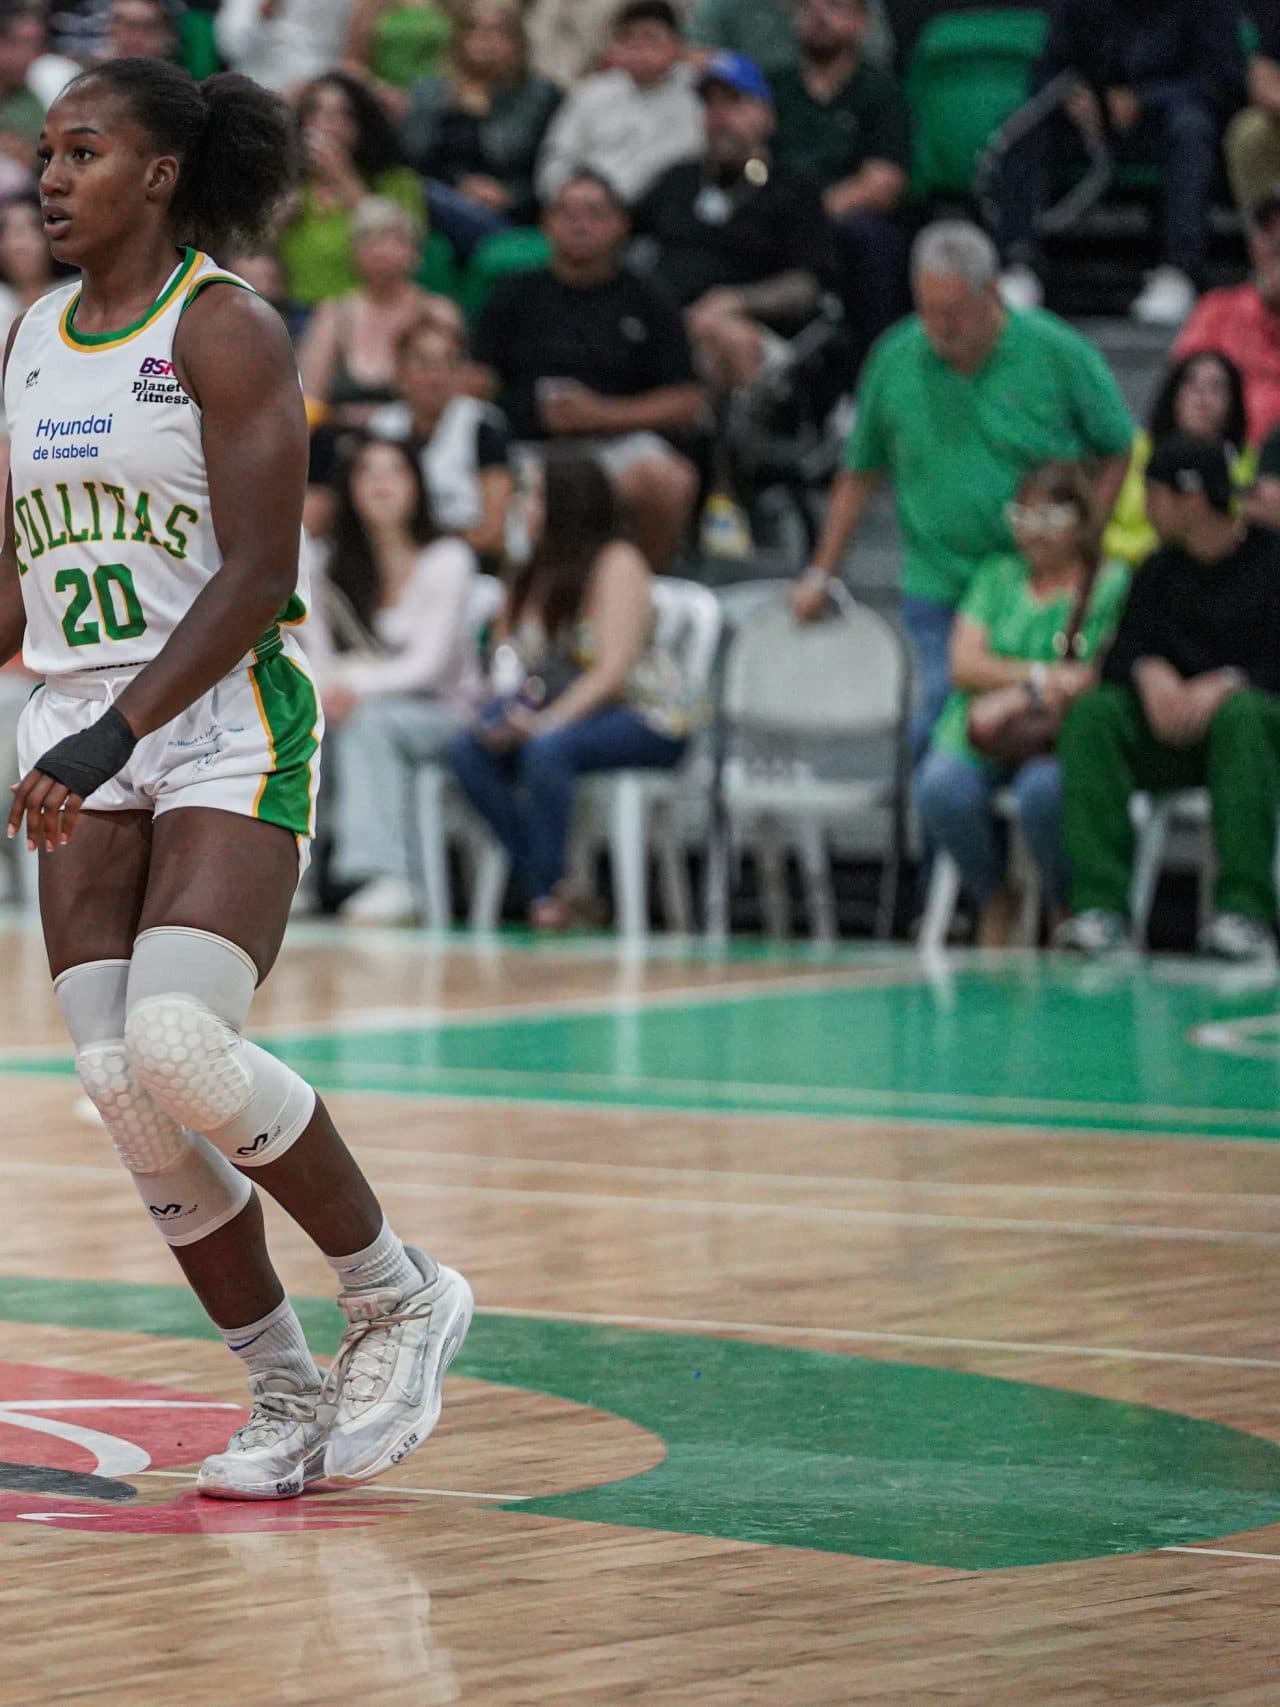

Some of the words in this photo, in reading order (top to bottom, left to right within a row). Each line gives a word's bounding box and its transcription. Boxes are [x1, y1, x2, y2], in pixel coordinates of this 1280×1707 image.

[131, 379, 181, 393] planet
[136, 391, 190, 405] fitness
[35, 413, 113, 441] Hyundai
[32, 445, 49, 460] de
[52, 443, 99, 460] Isabela
[54, 563, 148, 647] 20
